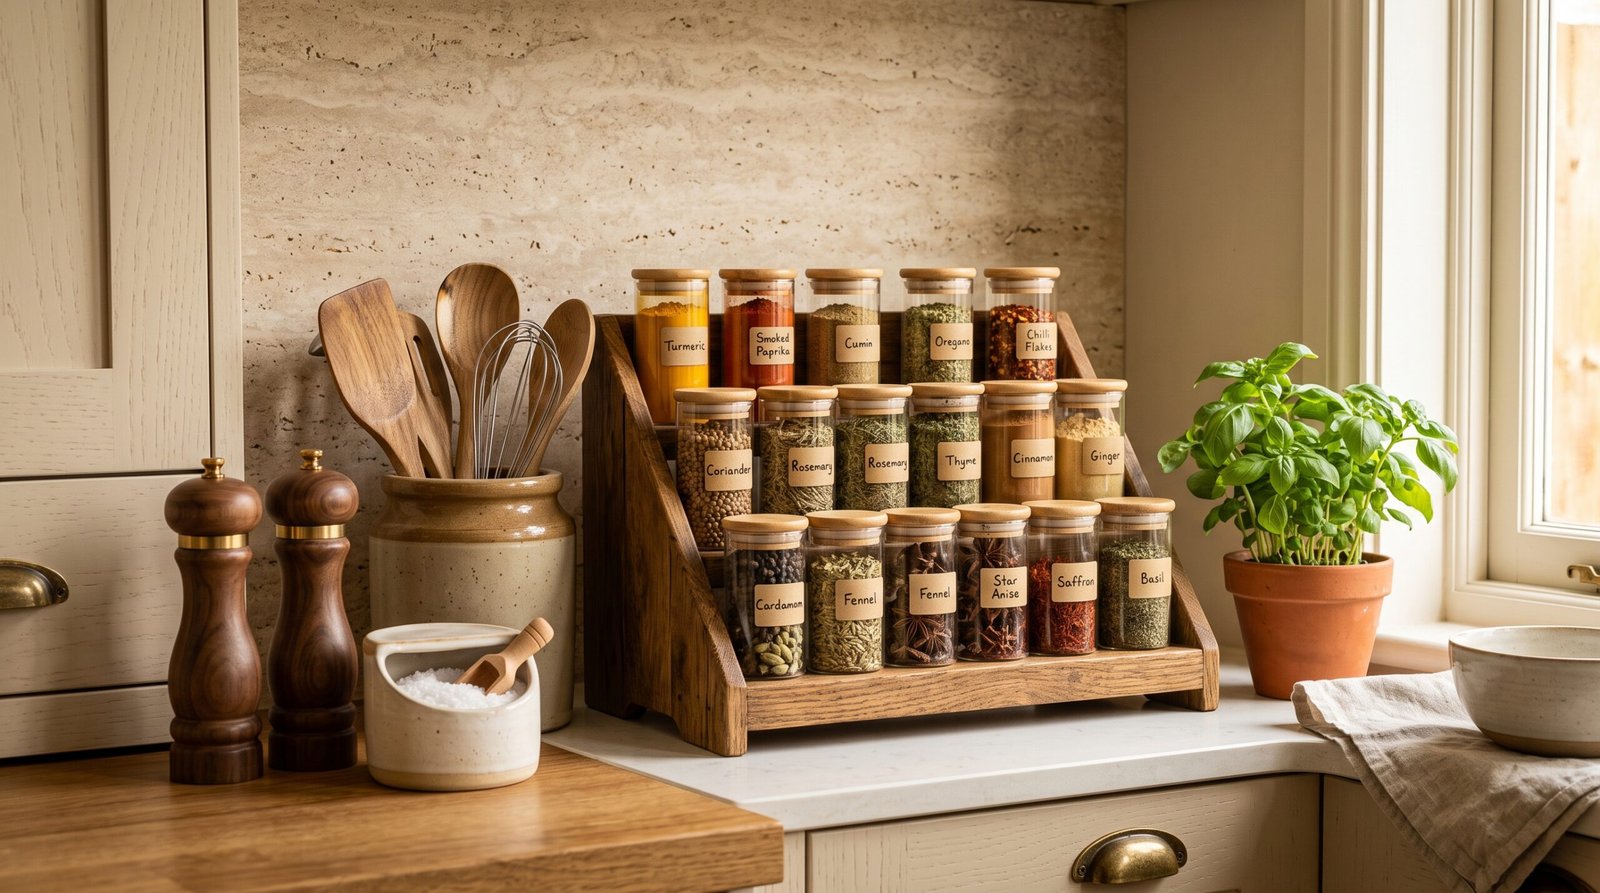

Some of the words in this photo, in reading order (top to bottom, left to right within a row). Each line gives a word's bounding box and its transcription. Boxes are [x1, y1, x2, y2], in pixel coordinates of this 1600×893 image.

[756, 332, 790, 343] Smoked
[1027, 329, 1050, 340] Chilli
[664, 340, 706, 352] Turmeric
[845, 337, 873, 349] Cumin
[935, 336, 970, 350] Oregano
[1025, 342, 1052, 352] Flakes
[756, 346, 790, 360] Paprika
[868, 456, 908, 471] Rosemary
[945, 454, 977, 470] Thyme
[1013, 452, 1054, 464] Cinnamon
[1090, 449, 1121, 466] Ginger
[706, 464, 752, 476] Coriander
[791, 459, 833, 475] Rosemary
[993, 574, 1018, 586] Star
[1057, 574, 1095, 588] Saffron
[1141, 572, 1165, 585] Basil
[844, 592, 877, 606] Fennel
[919, 587, 951, 600] Fennel
[991, 588, 1020, 600] Anise
[756, 599, 803, 611] Cardamom
